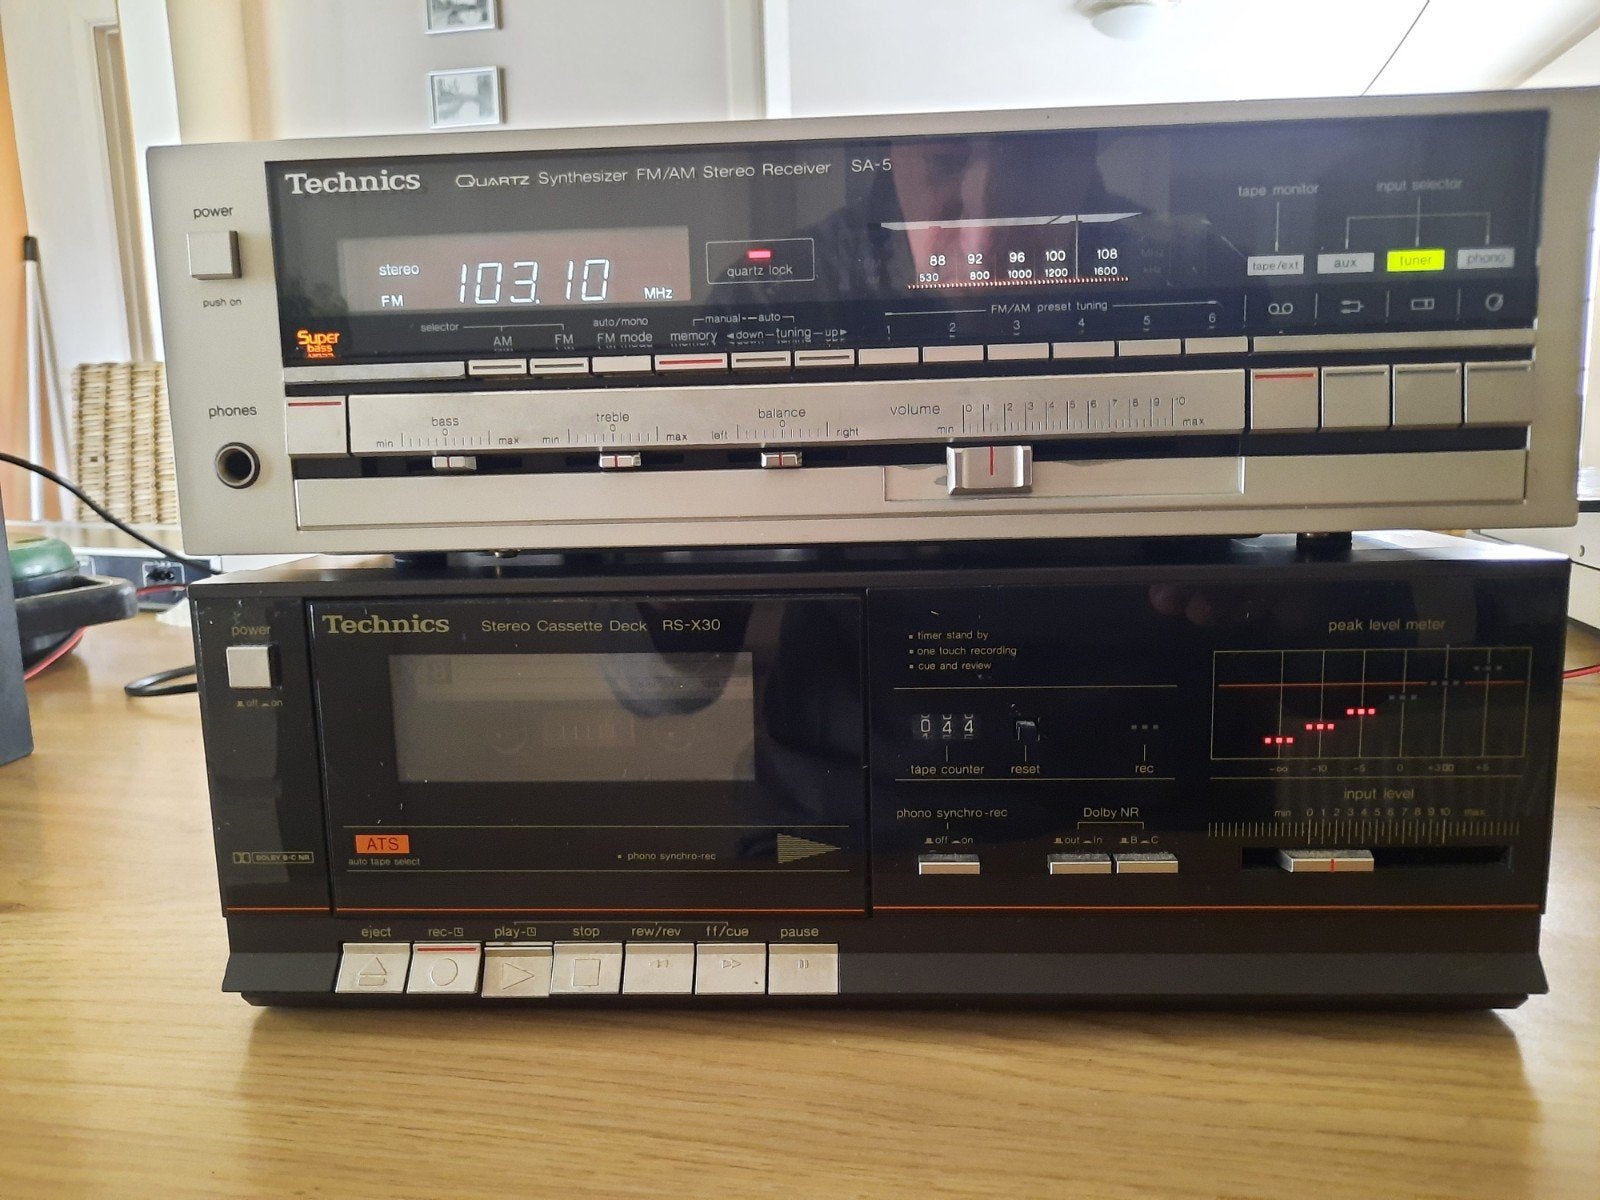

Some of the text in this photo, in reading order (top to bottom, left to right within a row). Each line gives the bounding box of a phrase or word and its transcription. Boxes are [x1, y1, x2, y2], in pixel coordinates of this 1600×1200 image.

[455, 159, 892, 187] QUARTZ Synthesizer FM/AM Stereo Receiver SA-5
[284, 170, 421, 195] Technics
[1376, 178, 1463, 193] input selector
[1238, 183, 1319, 198] tape monitor
[193, 206, 234, 219] power
[929, 248, 1118, 266] 88 92 96 100 108
[1400, 254, 1432, 266] tuner
[1466, 252, 1506, 266] phono
[1252, 260, 1299, 272] tape/ext
[1334, 258, 1357, 268] aux
[379, 264, 420, 276] stereo
[727, 264, 793, 278] quartz lock
[919, 266, 1118, 282] 530 800 1000 1200 1600
[644, 287, 673, 300] MHz
[203, 298, 226, 308] push
[382, 295, 404, 307] FM
[991, 300, 1108, 314] FM/AM preset tuning
[593, 316, 648, 327] auto/mono
[705, 314, 741, 324] manual
[758, 312, 781, 322] auto
[1143, 316, 1150, 326] 5
[1208, 313, 1216, 324] 6
[420, 322, 459, 332] selector
[949, 322, 957, 333] 2
[1014, 320, 1020, 330] 3
[1078, 318, 1085, 328] 4
[297, 329, 340, 346] Super
[597, 331, 652, 343] FM mode
[670, 331, 718, 344] memory
[736, 326, 840, 340] down tuning up
[493, 336, 512, 347] AM
[555, 334, 574, 344] FM
[307, 344, 333, 352] bass
[208, 404, 257, 418] phones
[758, 408, 806, 419] balance
[890, 404, 940, 416] volume
[432, 416, 459, 427] bass
[596, 412, 630, 422] treble
[1182, 418, 1204, 426] max
[711, 430, 728, 440] left
[836, 428, 858, 439] right
[937, 425, 954, 434] min
[499, 436, 518, 445] max
[542, 435, 560, 444] min
[666, 432, 688, 441] max
[376, 439, 393, 448] min
[322, 614, 450, 634] Technics
[482, 619, 721, 632] Stereo Cassette Deck RS-X30
[1329, 618, 1446, 633] peak level meter
[232, 625, 271, 638] power
[918, 630, 988, 641] timer stand by
[917, 646, 1016, 658] one touch recording
[918, 662, 991, 670] cue and review
[910, 764, 984, 776] tape counter
[1011, 764, 1040, 774] reset
[1135, 764, 1154, 774] rec
[1344, 788, 1414, 800] input level
[897, 808, 932, 820] phono
[1084, 807, 1138, 818] Dolby NR
[367, 838, 399, 850] ATS
[935, 836, 948, 844] off
[1150, 836, 1158, 844] C
[627, 852, 716, 861] phono synchro-rec
[362, 927, 392, 938] eject
[573, 927, 600, 938] stop
[632, 926, 681, 938] rew/rev
[706, 926, 749, 937] ff/cue
[780, 927, 819, 938] pause
